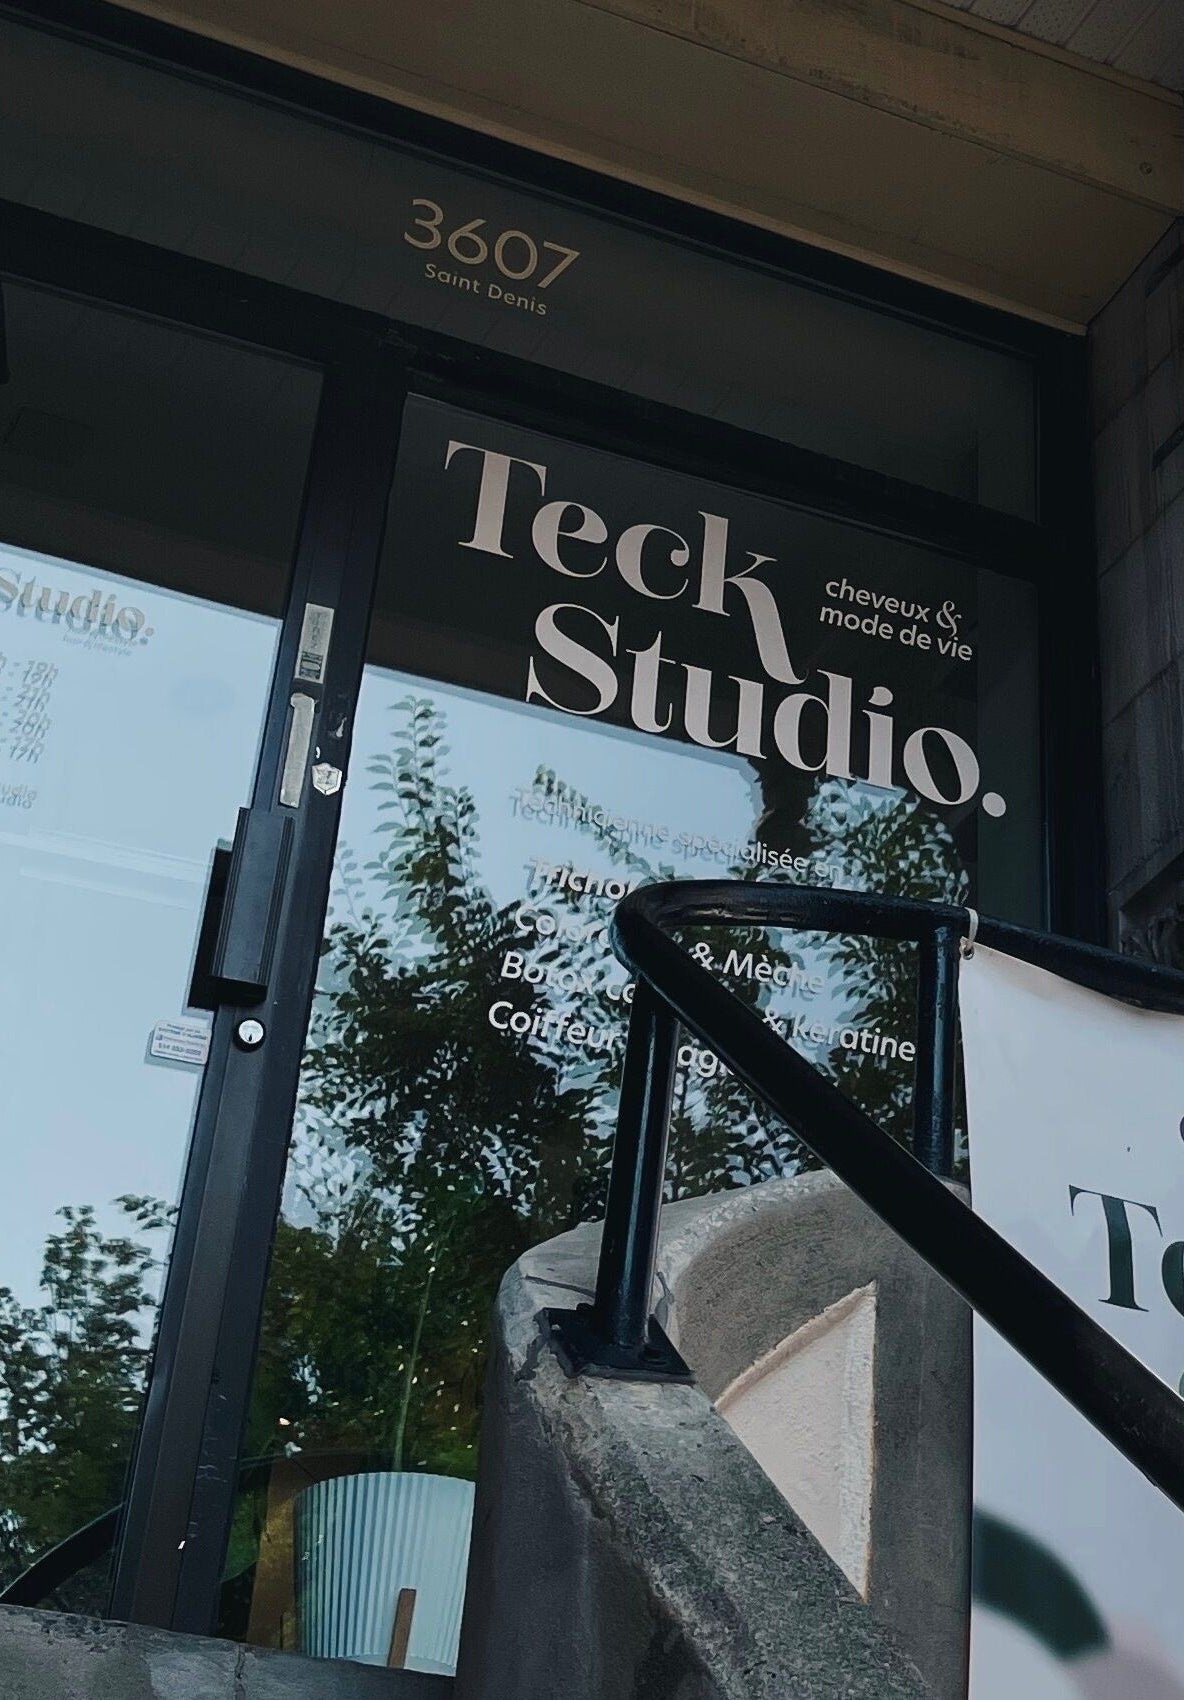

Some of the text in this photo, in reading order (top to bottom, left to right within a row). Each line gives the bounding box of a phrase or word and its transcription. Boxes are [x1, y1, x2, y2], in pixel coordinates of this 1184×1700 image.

[404, 199, 580, 289] 3607
[425, 263, 547, 316] Saint Denis
[445, 440, 807, 685] Teck
[820, 606, 973, 661] mode de vie
[826, 578, 962, 637] cheveux &
[526, 603, 1007, 818] Studio.
[488, 1001, 624, 1050] Coiffeur
